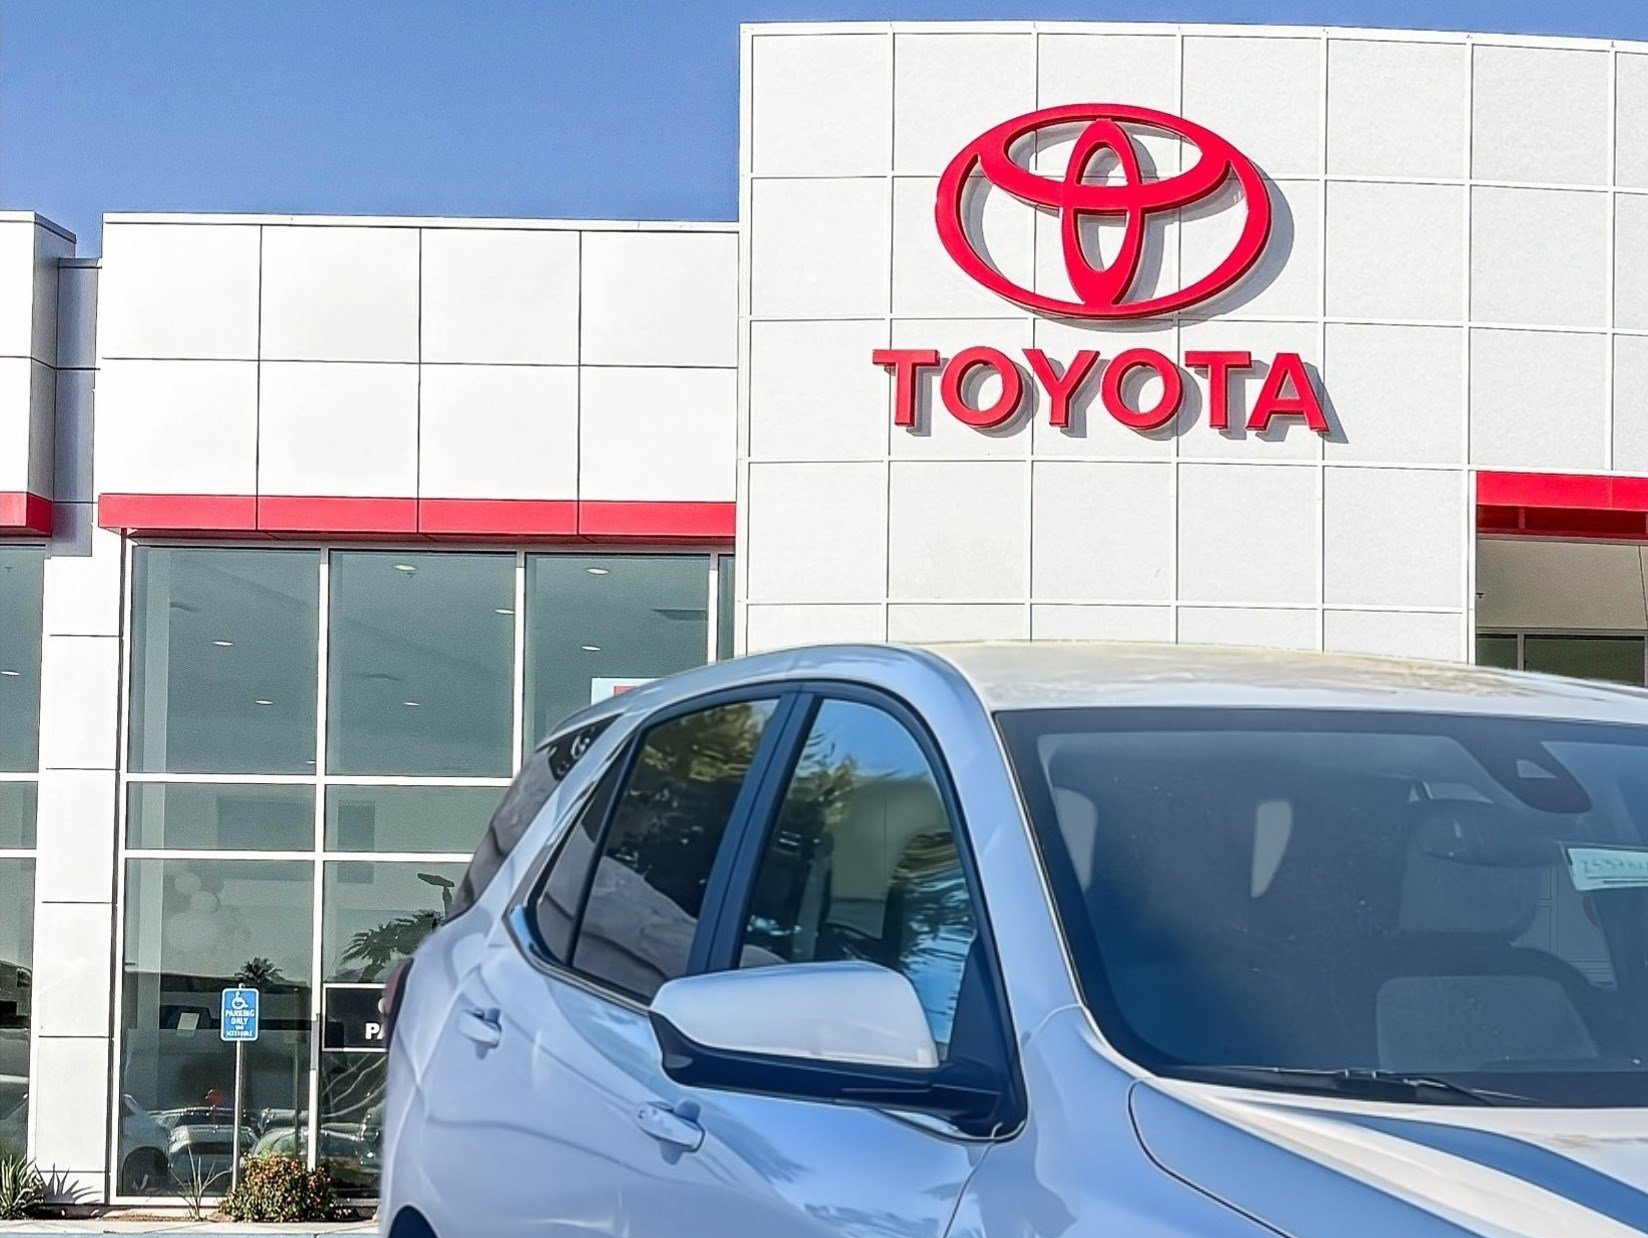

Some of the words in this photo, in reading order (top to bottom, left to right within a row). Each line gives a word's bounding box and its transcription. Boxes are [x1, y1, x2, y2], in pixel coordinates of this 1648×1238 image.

[873, 345, 1330, 433] TOYOTA
[225, 1009, 255, 1017] PARKING
[230, 1017, 248, 1025] ONLY
